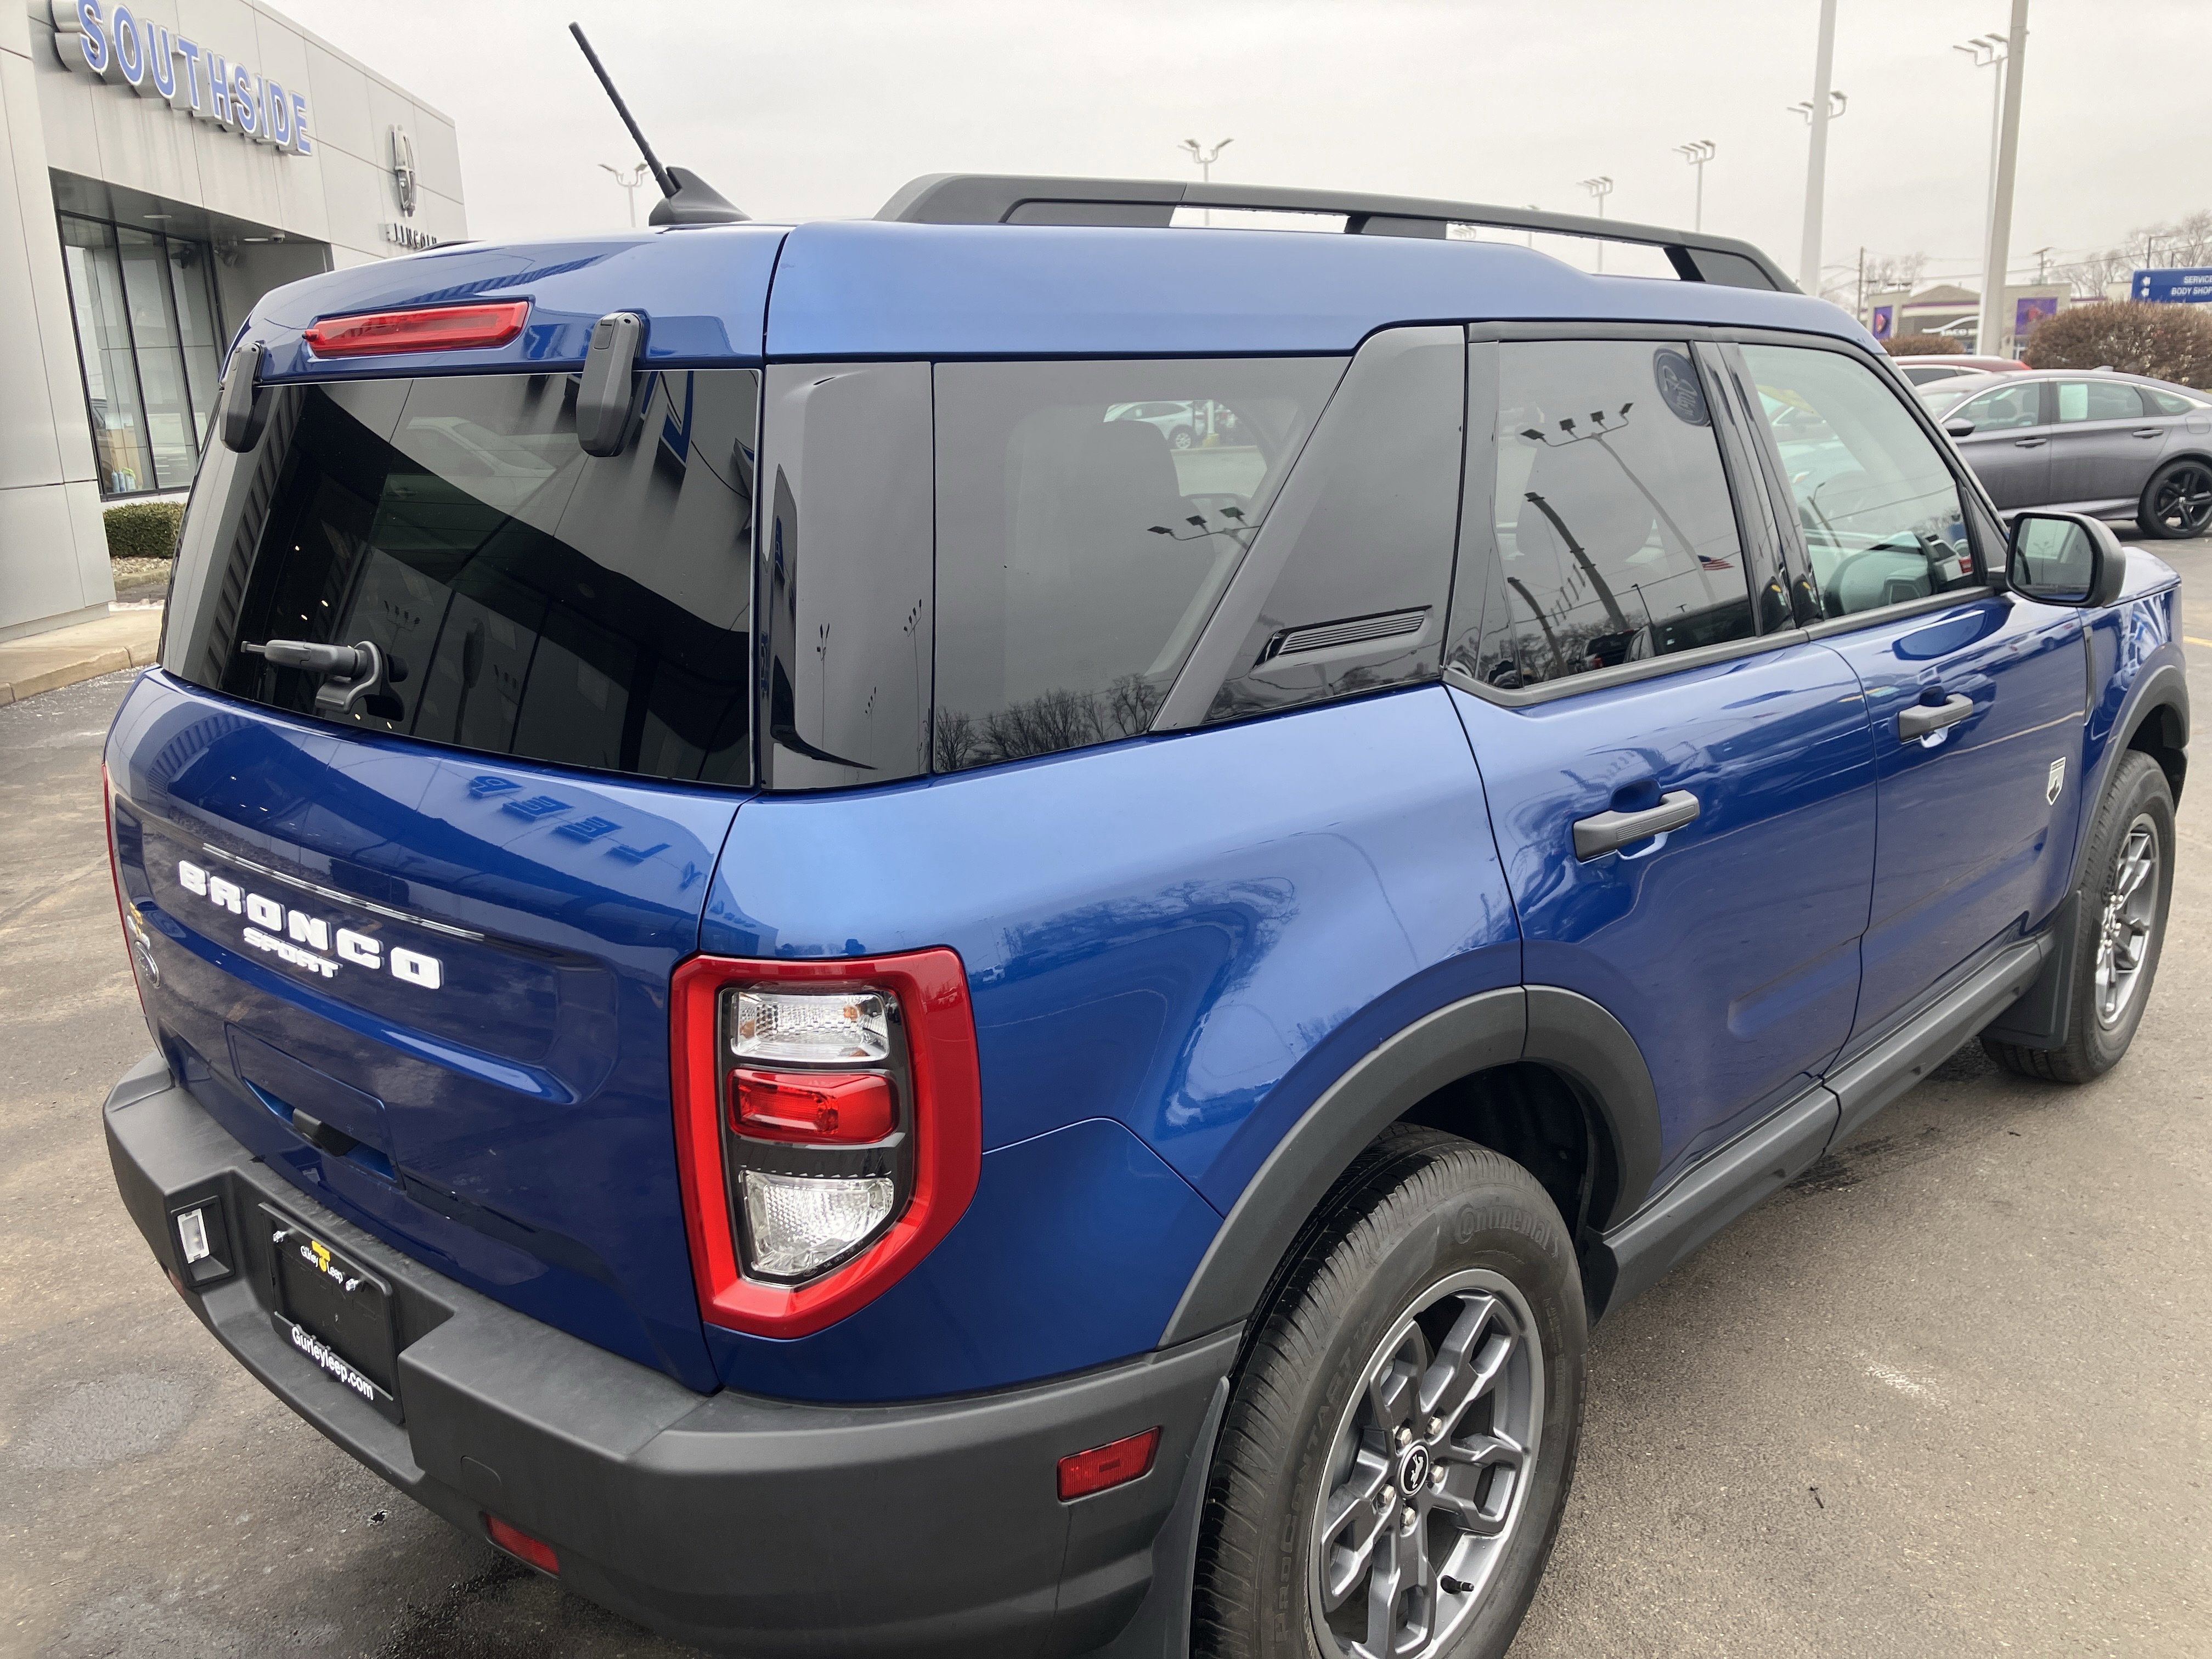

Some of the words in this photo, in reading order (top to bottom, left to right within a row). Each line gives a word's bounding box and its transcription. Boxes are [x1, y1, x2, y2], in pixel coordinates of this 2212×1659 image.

[77, 0, 312, 156] SOUTHSIDE
[2171, 287, 2192, 295] BODY
[2193, 286, 2212, 295] SHOP
[179, 860, 442, 989] BRONCO
[243, 927, 340, 978] SPORT
[292, 1327, 374, 1401] Gurleyleep.com
